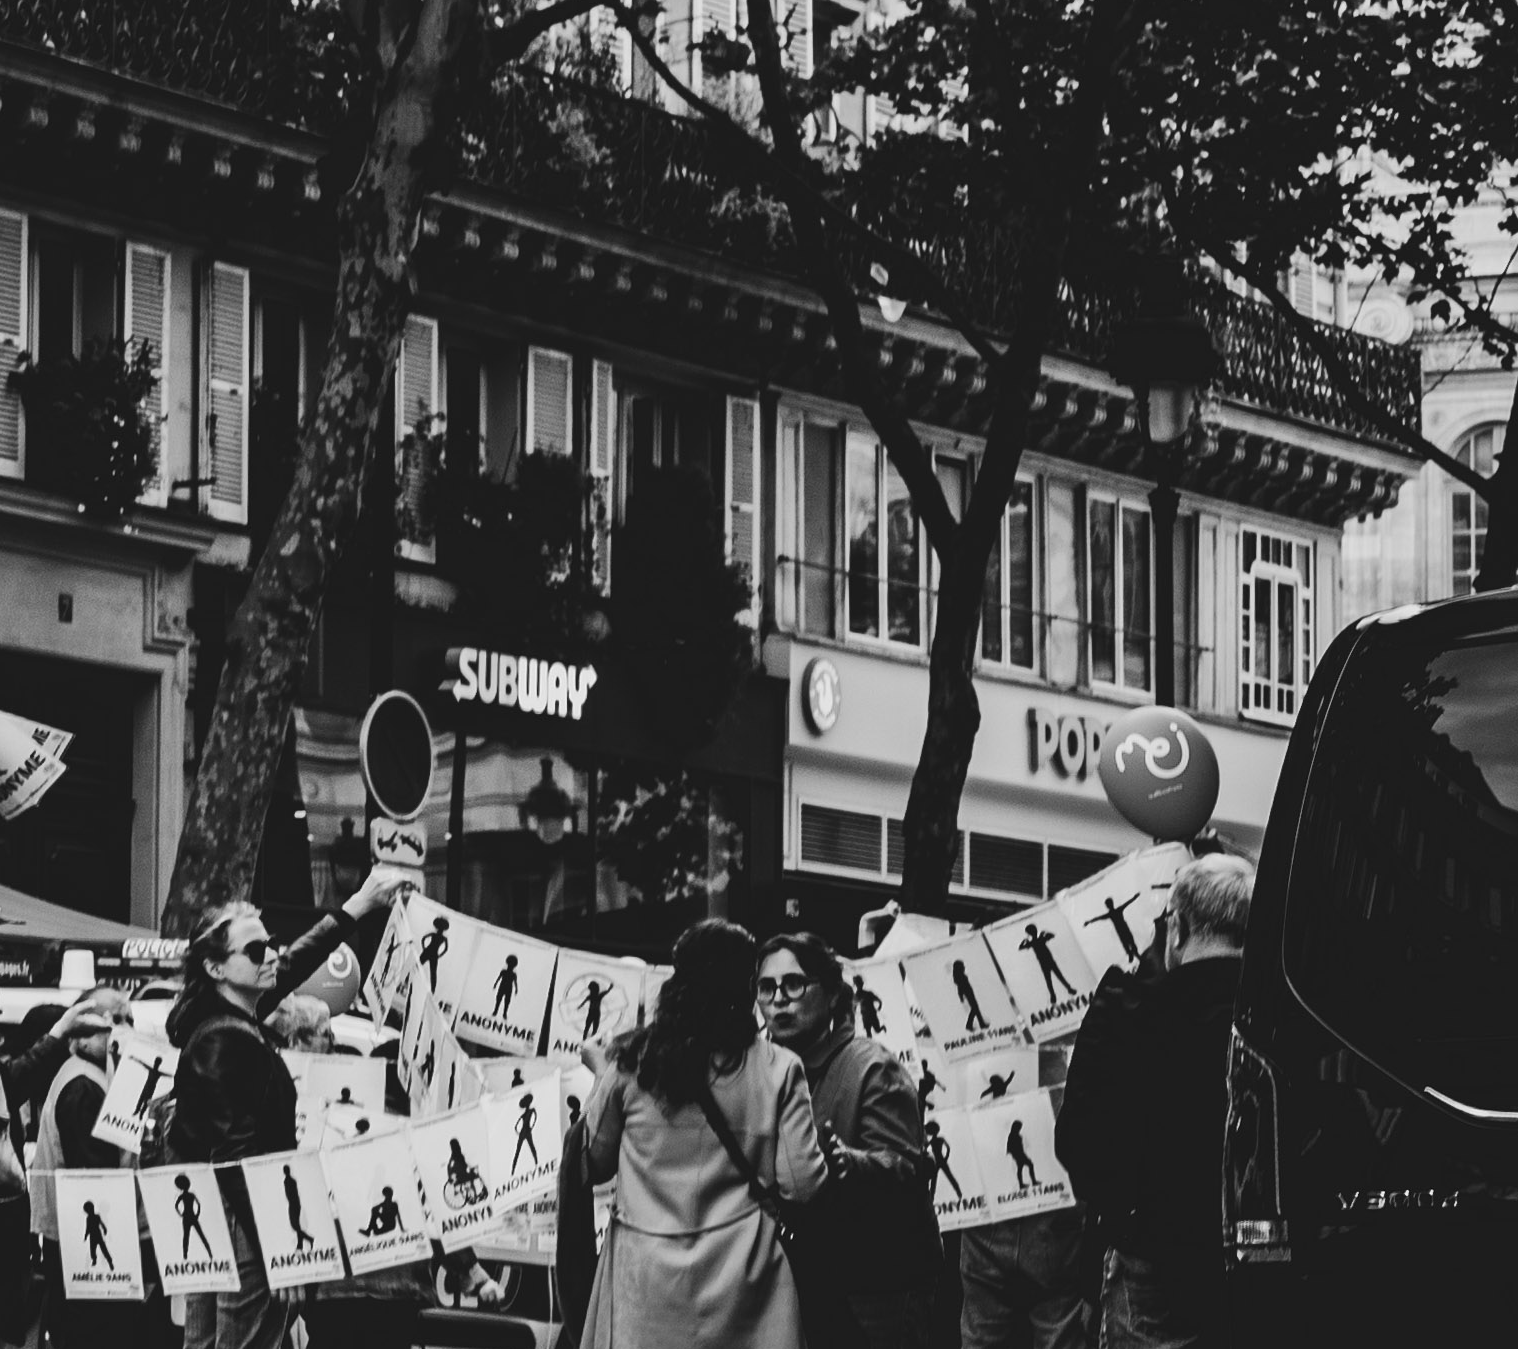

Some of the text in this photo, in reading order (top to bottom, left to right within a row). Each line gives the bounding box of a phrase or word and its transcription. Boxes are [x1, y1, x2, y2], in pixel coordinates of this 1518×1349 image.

[453, 646, 597, 720] SUBWAY
[460, 1010, 535, 1042] ANONYME
[101, 1112, 144, 1137] ANON
[495, 1157, 559, 1201] ANONYME
[164, 1247, 338, 1278] ANONYME ANONYME
